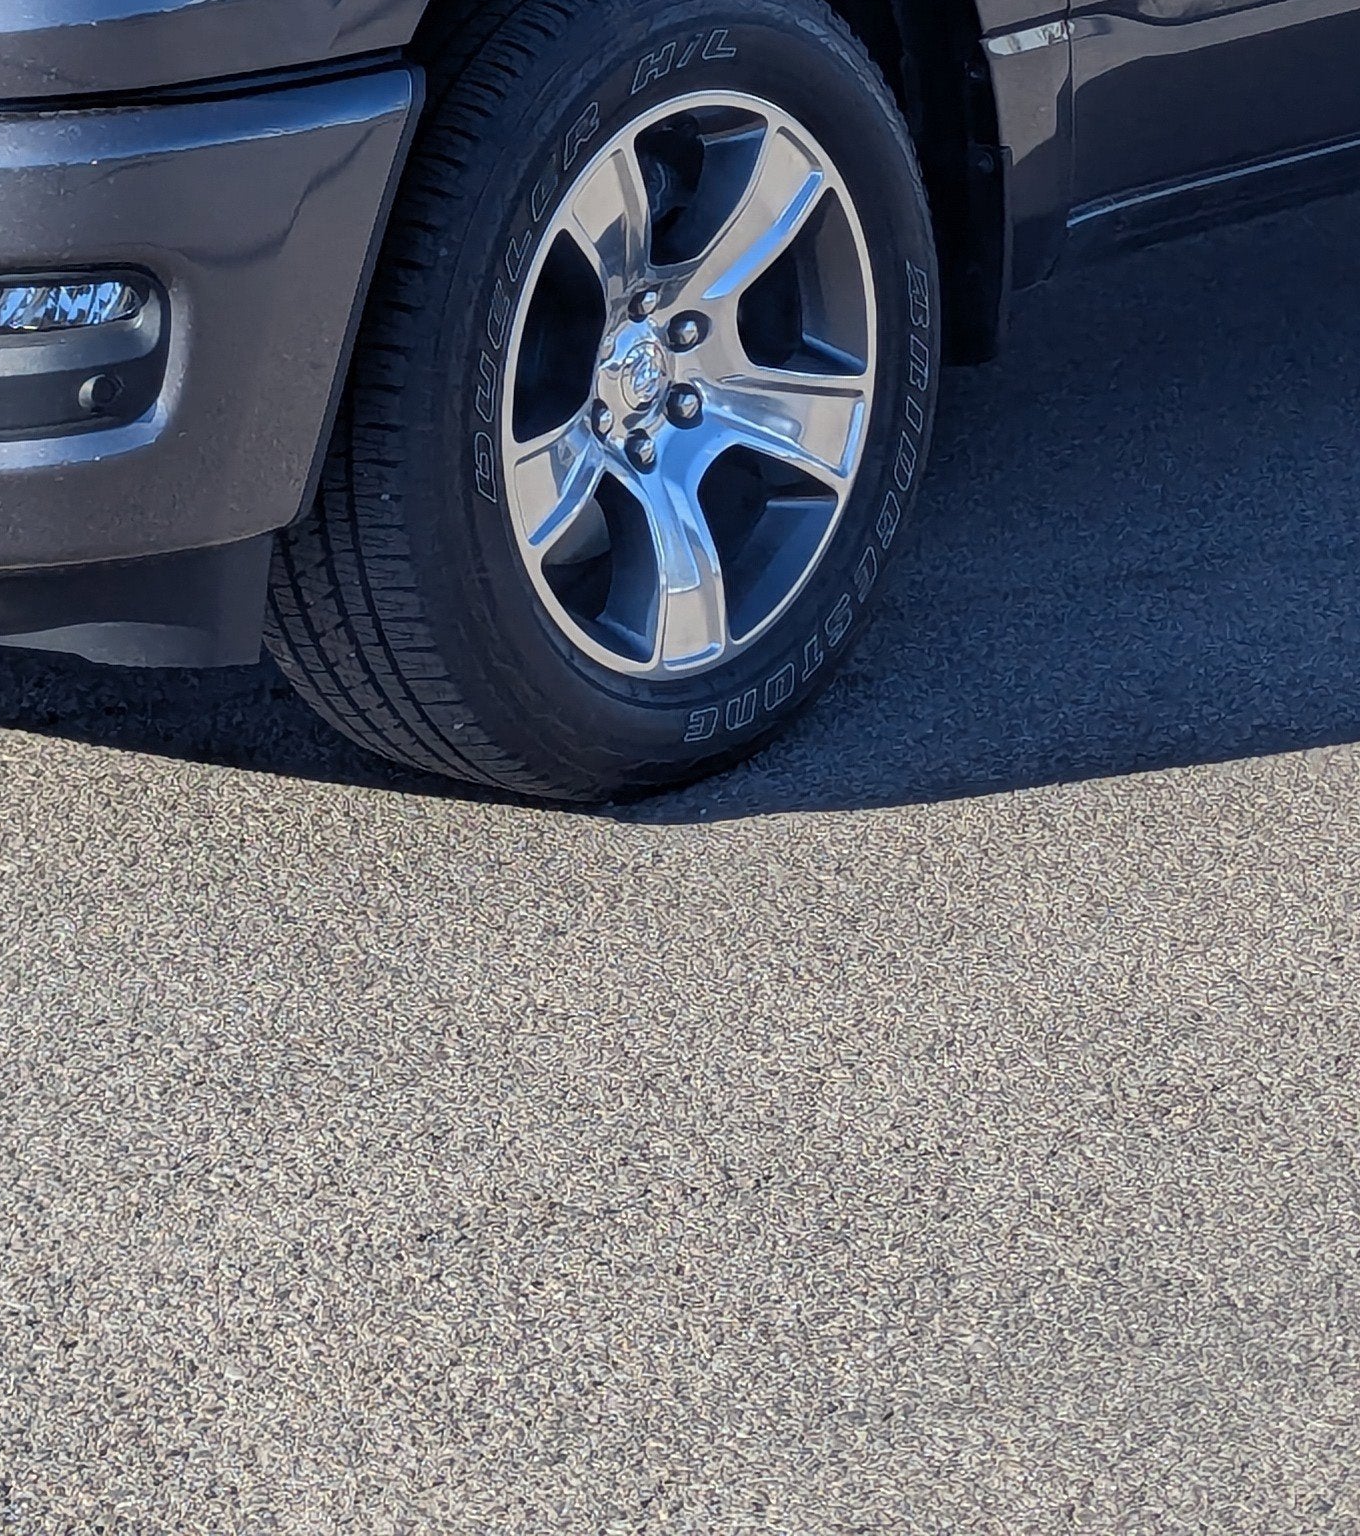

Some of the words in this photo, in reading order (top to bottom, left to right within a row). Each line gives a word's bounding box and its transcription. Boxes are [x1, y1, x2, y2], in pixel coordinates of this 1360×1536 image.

[473, 101, 600, 504] DUELER
[630, 28, 737, 95] H/L
[683, 260, 931, 743] BRIDGESTONE
